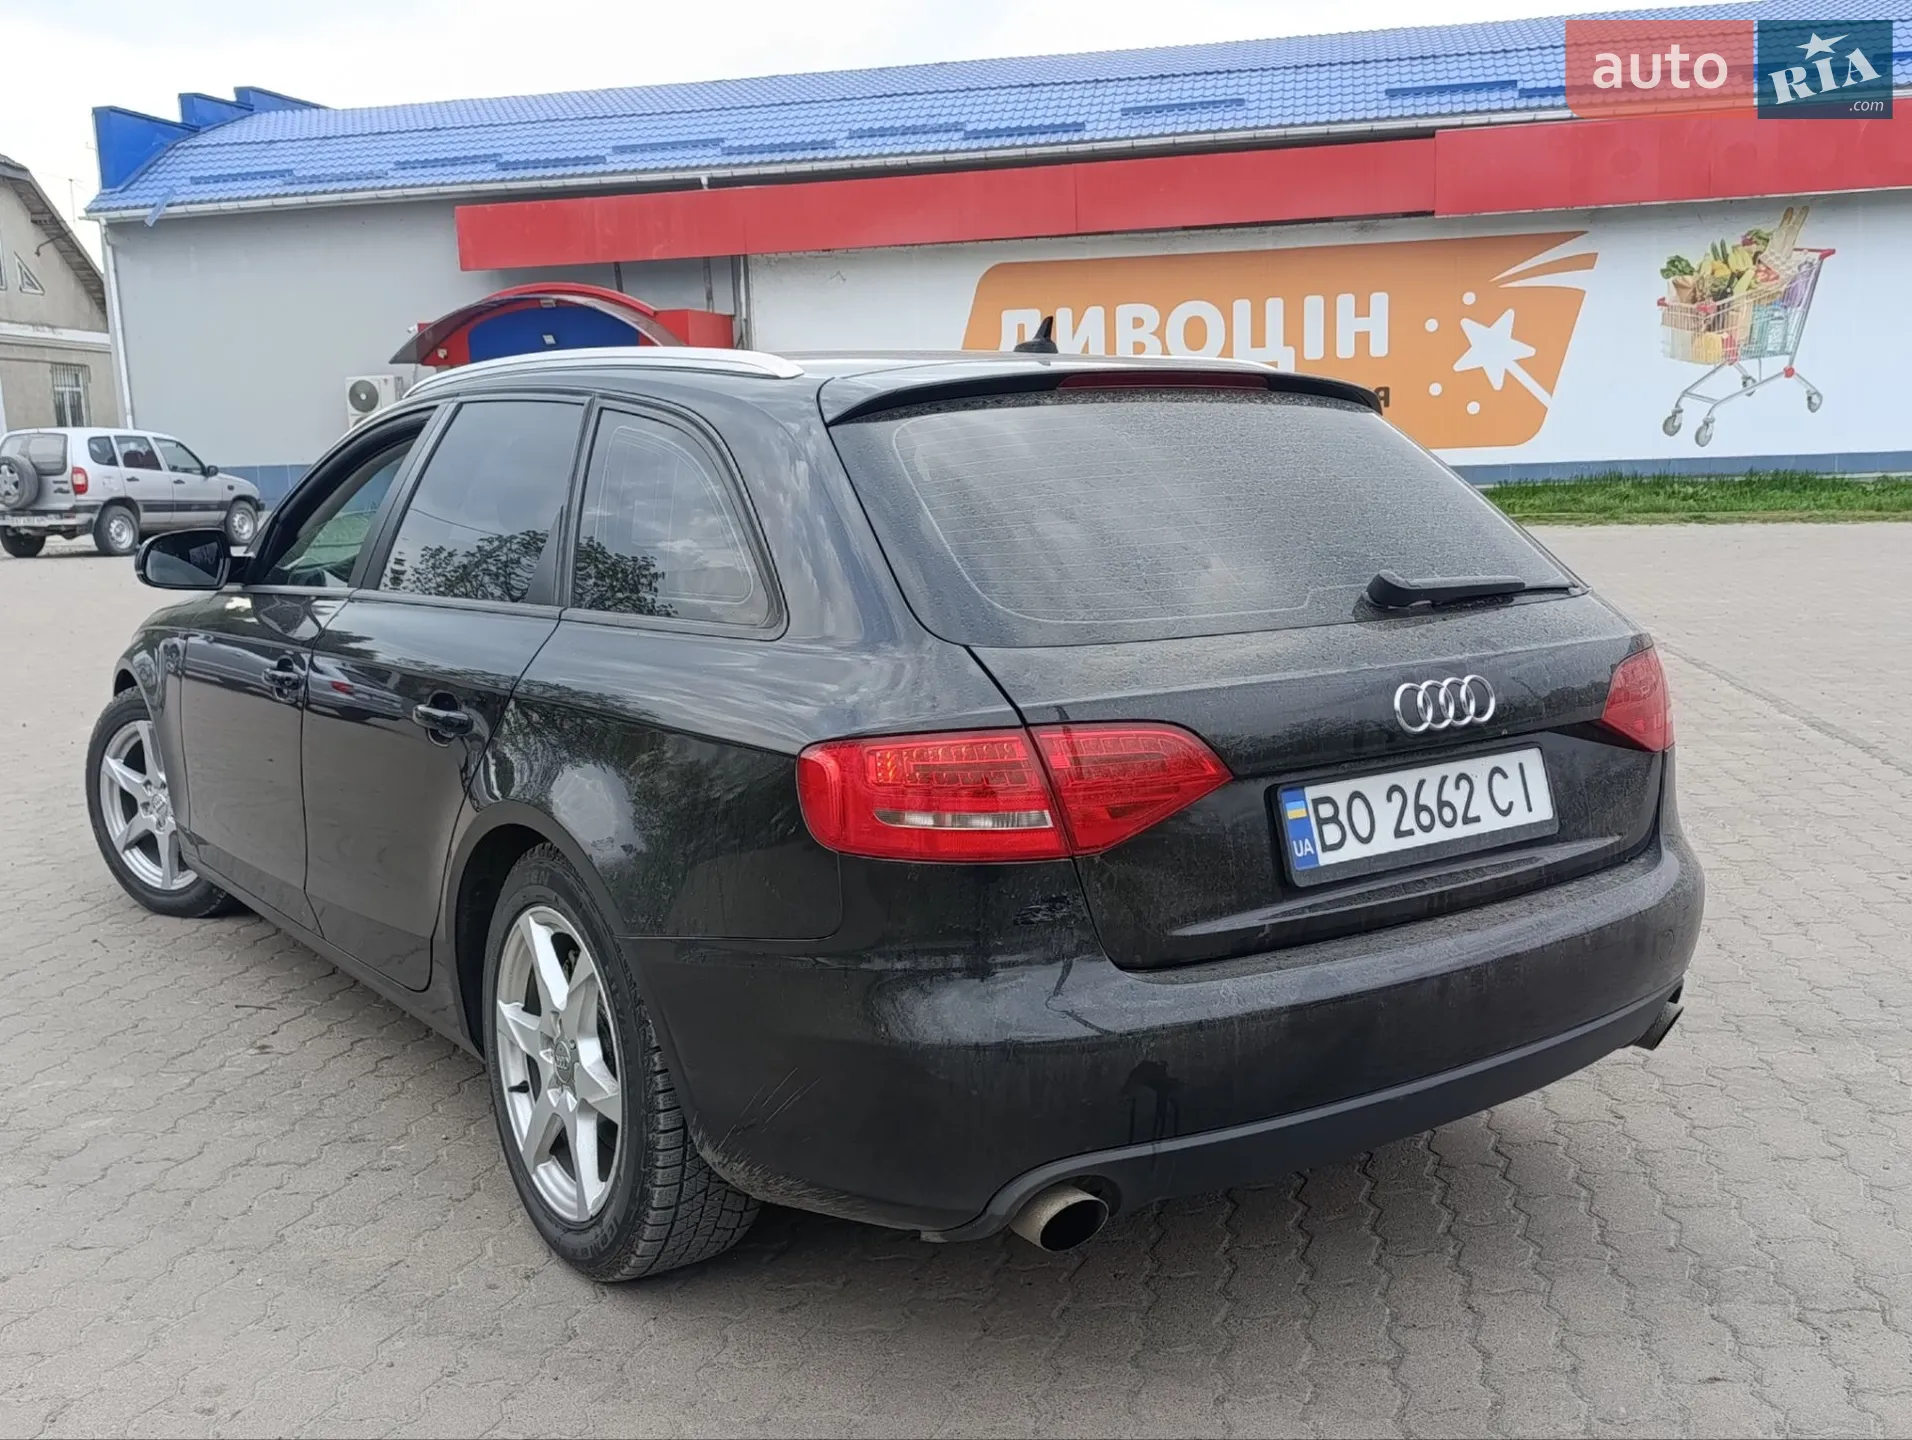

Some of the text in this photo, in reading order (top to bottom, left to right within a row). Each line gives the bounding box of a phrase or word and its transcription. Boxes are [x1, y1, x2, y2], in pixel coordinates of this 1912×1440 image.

[1311, 762, 1533, 854] BO 2662 CI
[1293, 840, 1314, 857] UA
